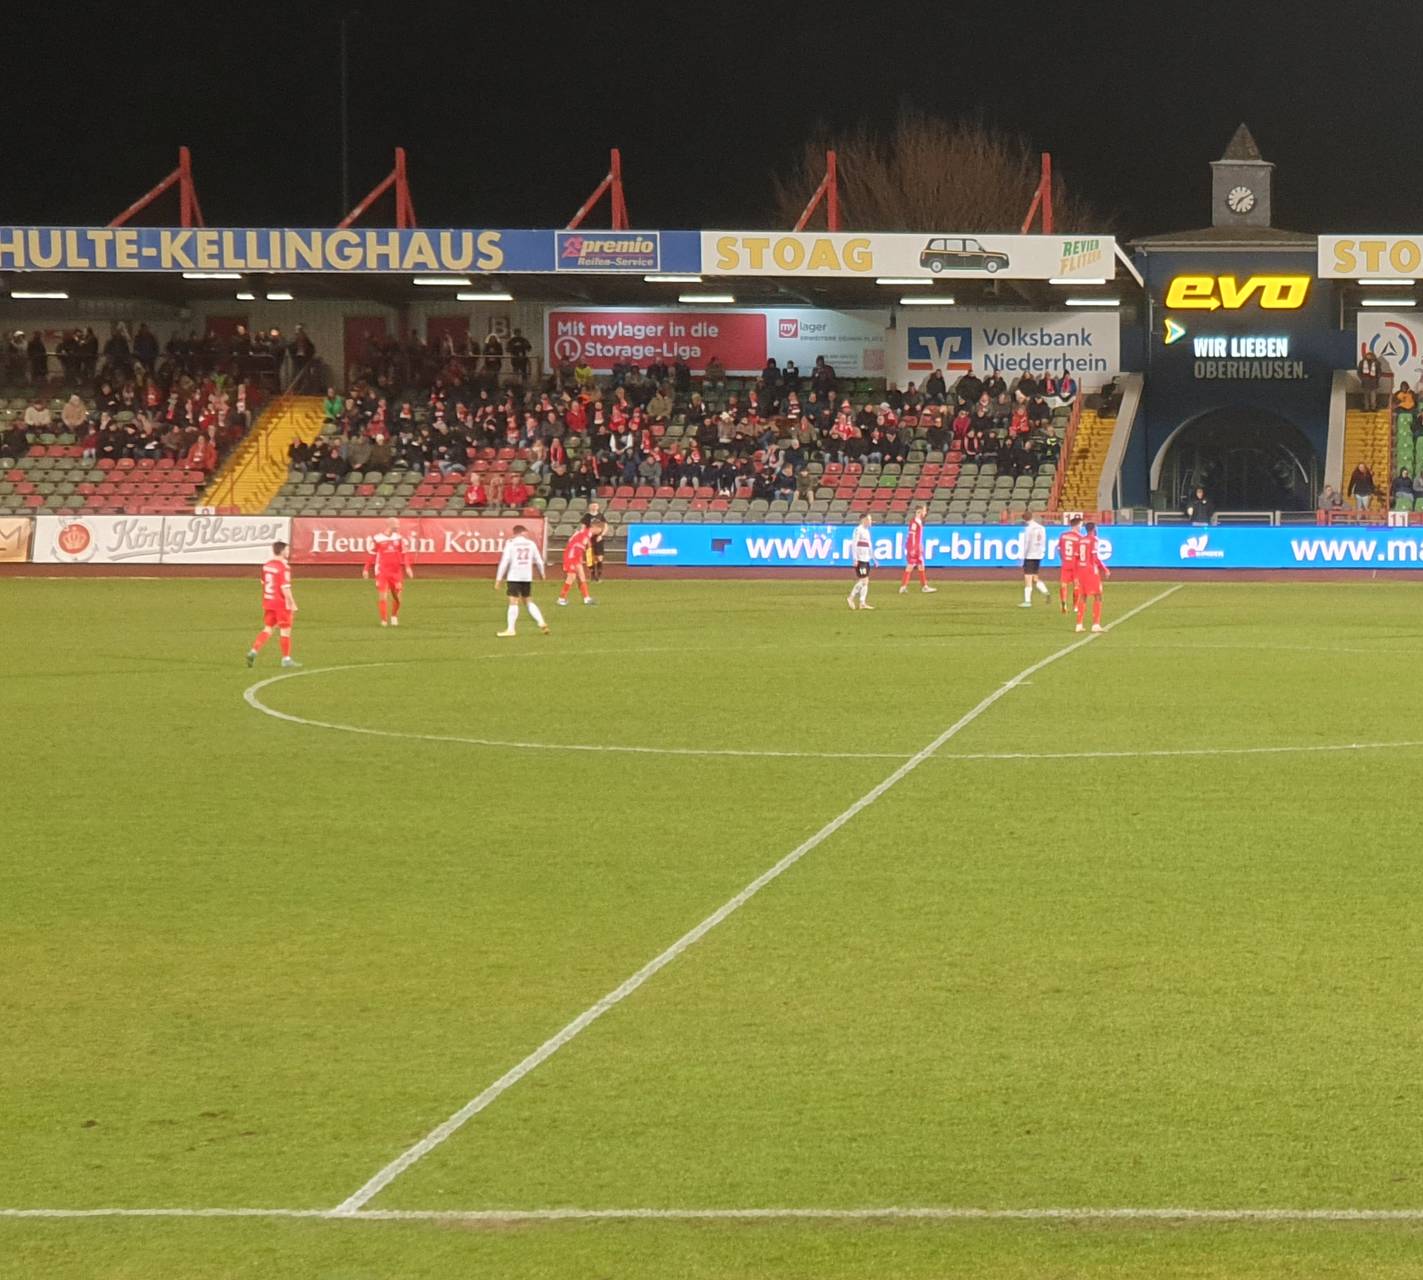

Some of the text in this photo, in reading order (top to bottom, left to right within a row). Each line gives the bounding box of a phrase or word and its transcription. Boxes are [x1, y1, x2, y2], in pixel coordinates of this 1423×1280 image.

[580, 237, 654, 256] premio
[716, 236, 873, 272] STOAG
[1063, 240, 1100, 256] REVIER
[578, 257, 654, 266] Reifen-Service
[1166, 276, 1310, 311] evo
[557, 321, 719, 340] Mit mylager in die
[983, 328, 1092, 346] Volksbank
[585, 342, 701, 360] Storage-Liga
[1193, 337, 1288, 358] WIR LIEBEN
[984, 353, 1107, 372] Niederrhein
[1194, 361, 1309, 379] OBERHAUSEN.
[106, 517, 283, 553] König Pilsener
[310, 529, 377, 554] Heut
[443, 531, 505, 553] Köni
[516, 548, 530, 560] 22
